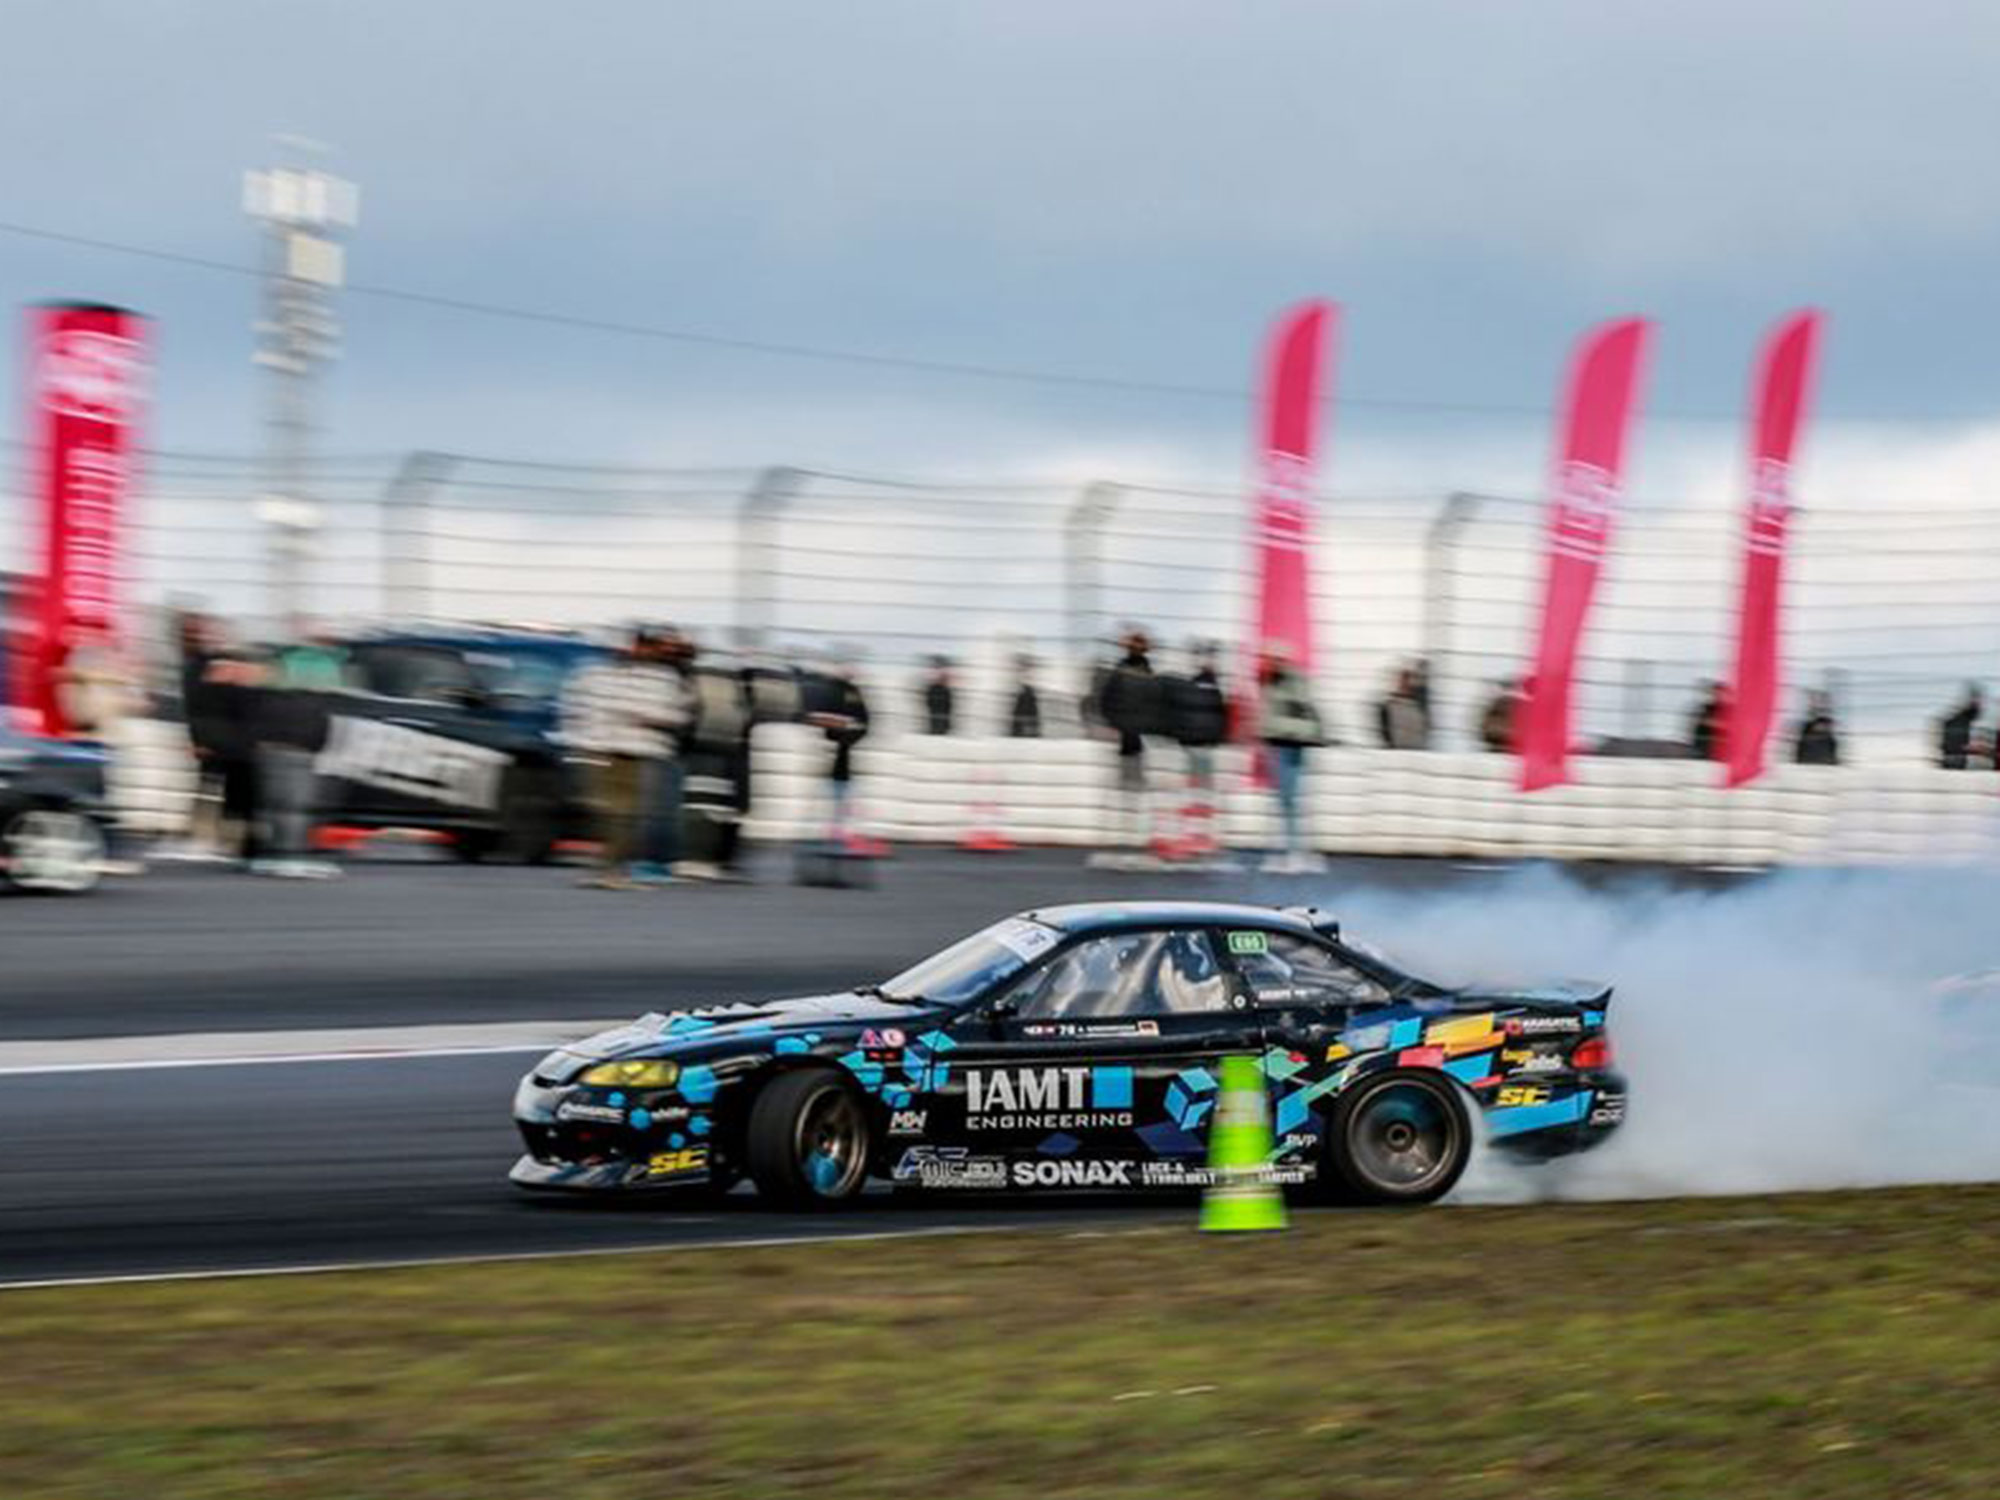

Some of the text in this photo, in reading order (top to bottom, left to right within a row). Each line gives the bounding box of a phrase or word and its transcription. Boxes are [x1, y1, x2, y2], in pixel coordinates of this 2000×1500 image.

[967, 1067, 1089, 1112] IAMT
[966, 1112, 1134, 1130] ENGINEERING
[1012, 1159, 1132, 1187] SONAX
